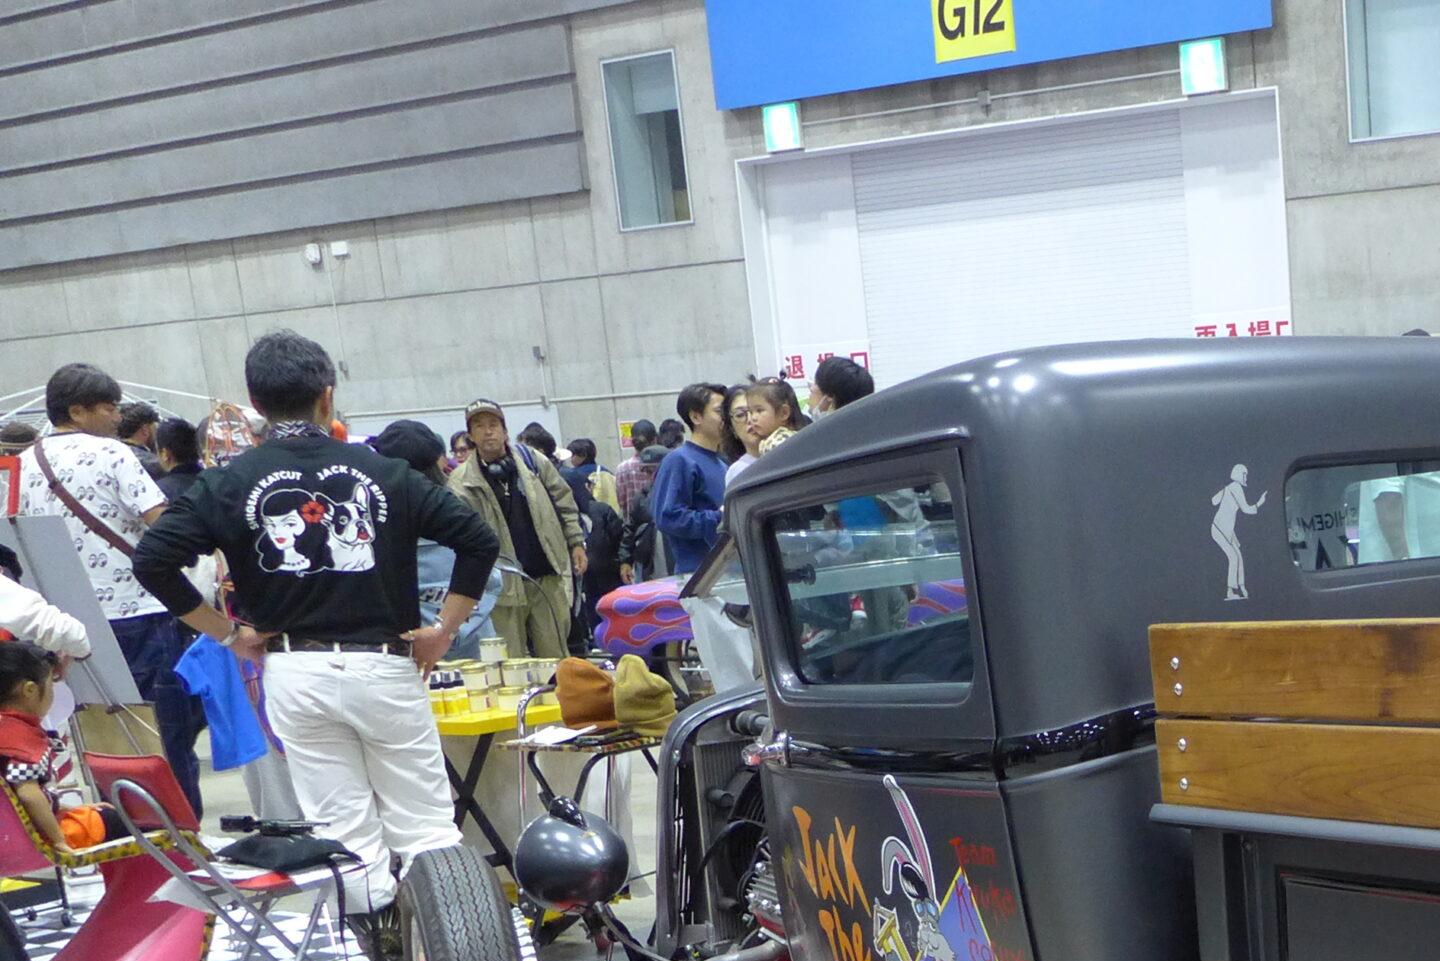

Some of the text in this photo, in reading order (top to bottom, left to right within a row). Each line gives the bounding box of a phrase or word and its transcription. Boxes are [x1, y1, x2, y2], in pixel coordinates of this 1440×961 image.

[785, 352, 869, 379] 退口
[258, 470, 303, 490] KATCUT
[316, 465, 388, 524] JACK THE RIPPER
